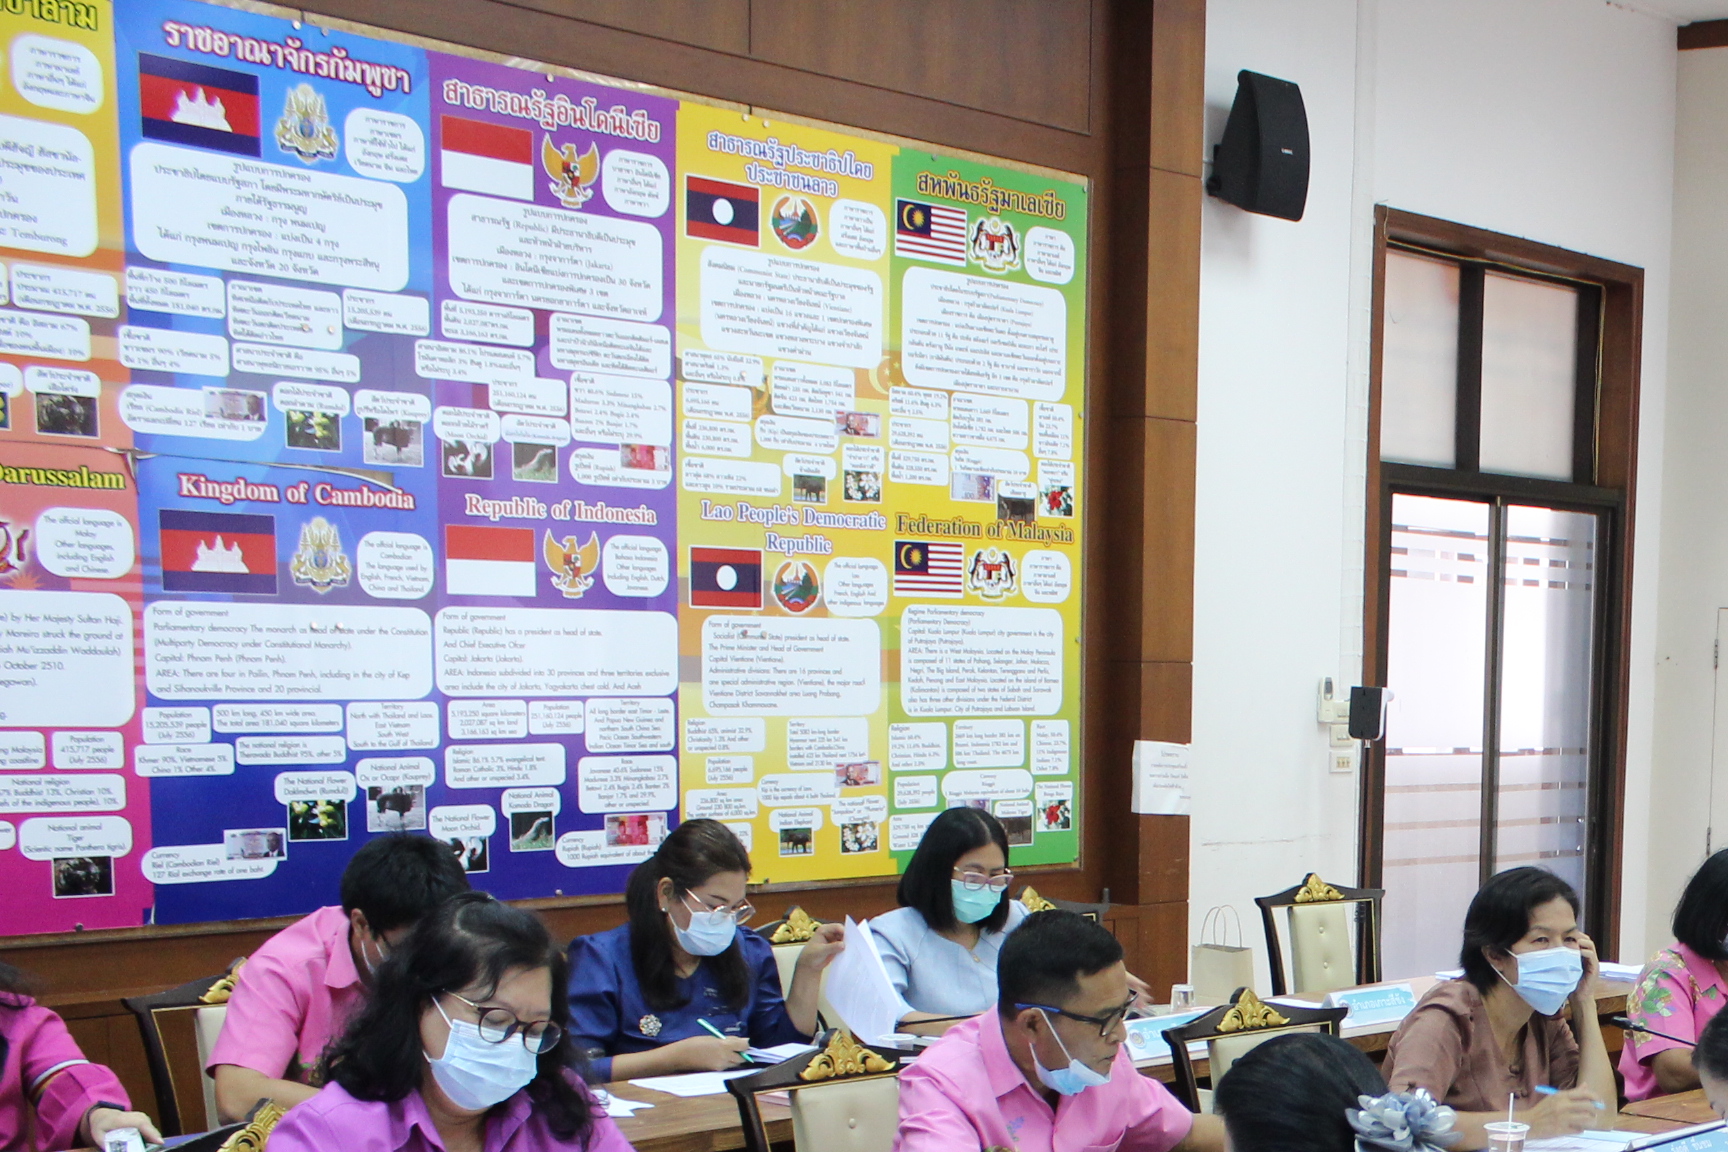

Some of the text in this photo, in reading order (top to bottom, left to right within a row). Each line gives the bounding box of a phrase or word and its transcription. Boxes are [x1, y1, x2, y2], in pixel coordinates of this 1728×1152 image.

[164, 21, 411, 97] ราชอาณาจักรกัมพูชา
[444, 80, 661, 142] สาธารณรัฐอินโดนีเซีย
[708, 132, 873, 179] สาธารณรัฐประชาธิปไตย
[746, 163, 838, 197] ประชาชนลาว
[917, 172, 1066, 220] สหพันธรัฐมาเลเซีย
[178, 473, 416, 511] Kingdom of Cambodia
[465, 494, 658, 526] Republic of Indonesia
[701, 500, 887, 530] Lao People's Democratic
[766, 532, 832, 556] Republic
[896, 513, 1075, 546] Federation of Malaysia
[153, 606, 229, 618] Form of government
[442, 612, 459, 620] Form
[461, 611, 468, 620] of
